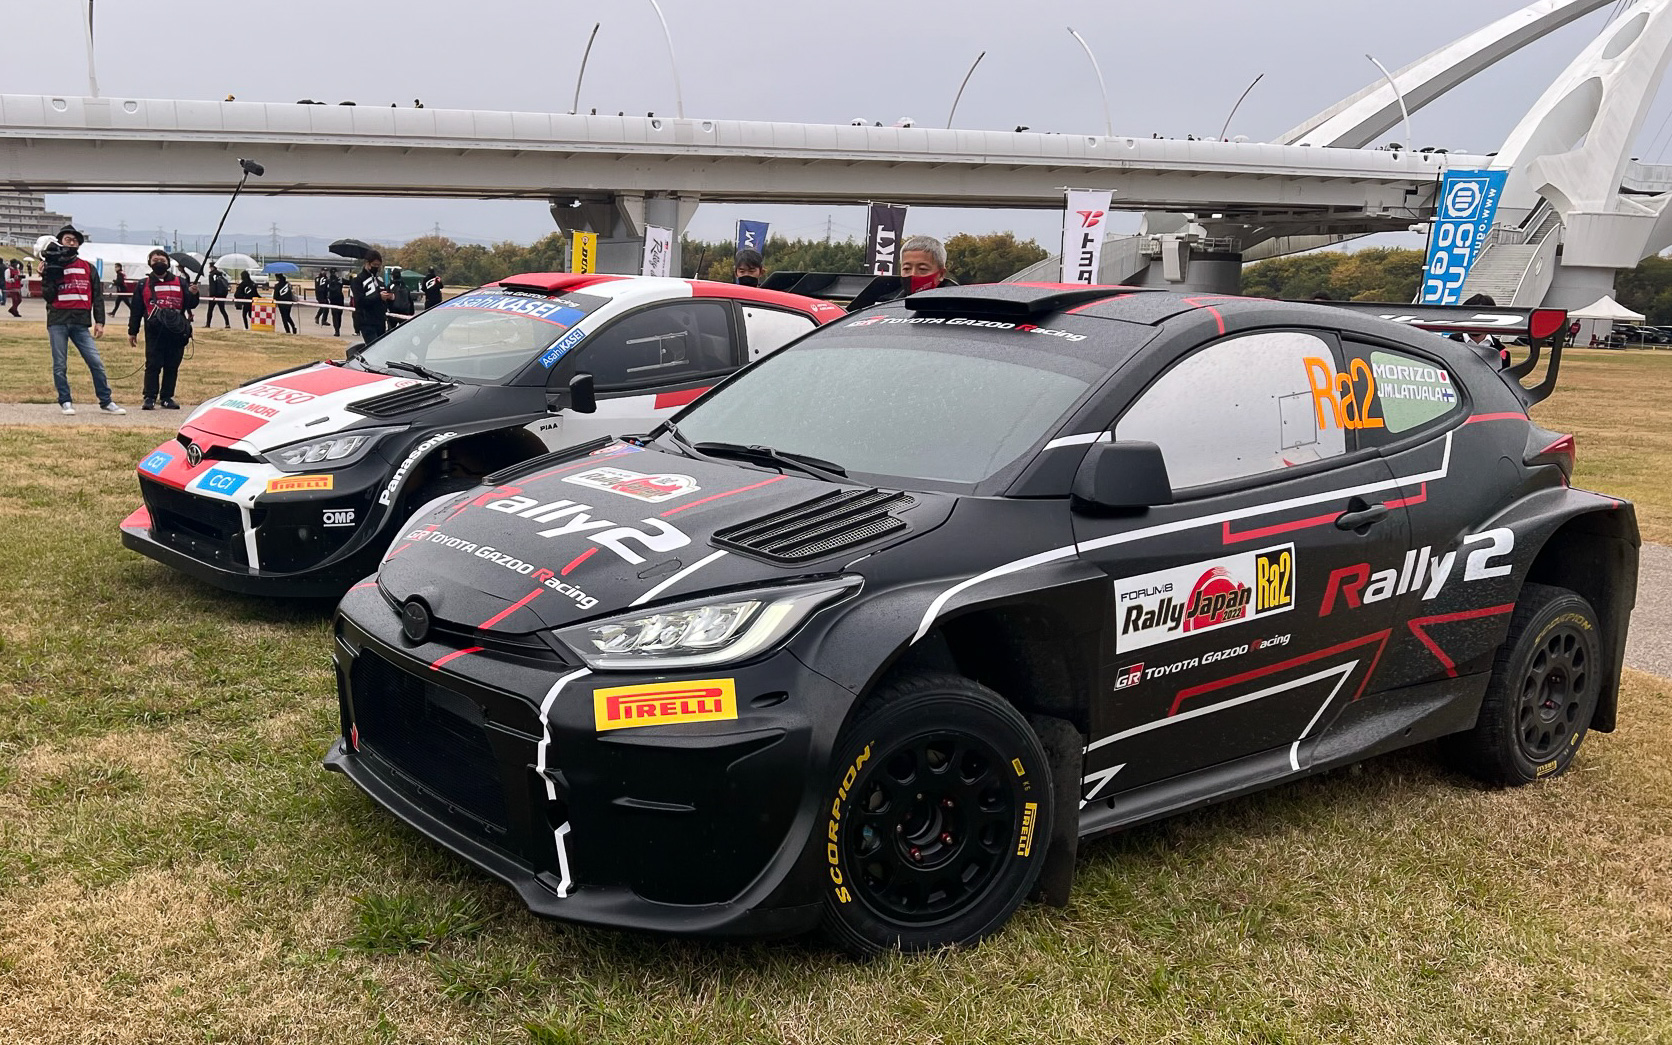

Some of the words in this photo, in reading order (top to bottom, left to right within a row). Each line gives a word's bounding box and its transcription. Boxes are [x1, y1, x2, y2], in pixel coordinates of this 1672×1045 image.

[945, 318, 1016, 329] GAZOO
[1015, 324, 1088, 342] Racing
[1302, 357, 1384, 430] Ra2
[1371, 363, 1436, 383] MORIZO
[239, 385, 316, 405] DENSO
[540, 423, 558, 431] PIAA
[271, 476, 329, 491] PIRELLI
[378, 431, 458, 506] Panasonic
[323, 512, 355, 524] OMP
[425, 531, 478, 553] TOYOTA
[474, 546, 535, 575] GAZOO
[531, 568, 599, 610] Racing
[1257, 551, 1292, 610] Ra2
[1121, 596, 1186, 636] Rally
[1186, 586, 1253, 622] Japan
[1221, 607, 1242, 622] 2022
[1116, 671, 1142, 689] GR
[1145, 657, 1199, 680] TOYOTA
[1201, 645, 1249, 665] GAZOO
[1249, 633, 1292, 652] Racing
[606, 688, 723, 721] PIRELLI
[827, 744, 872, 904] SCORPION
[1016, 802, 1038, 857] PIRELLI
